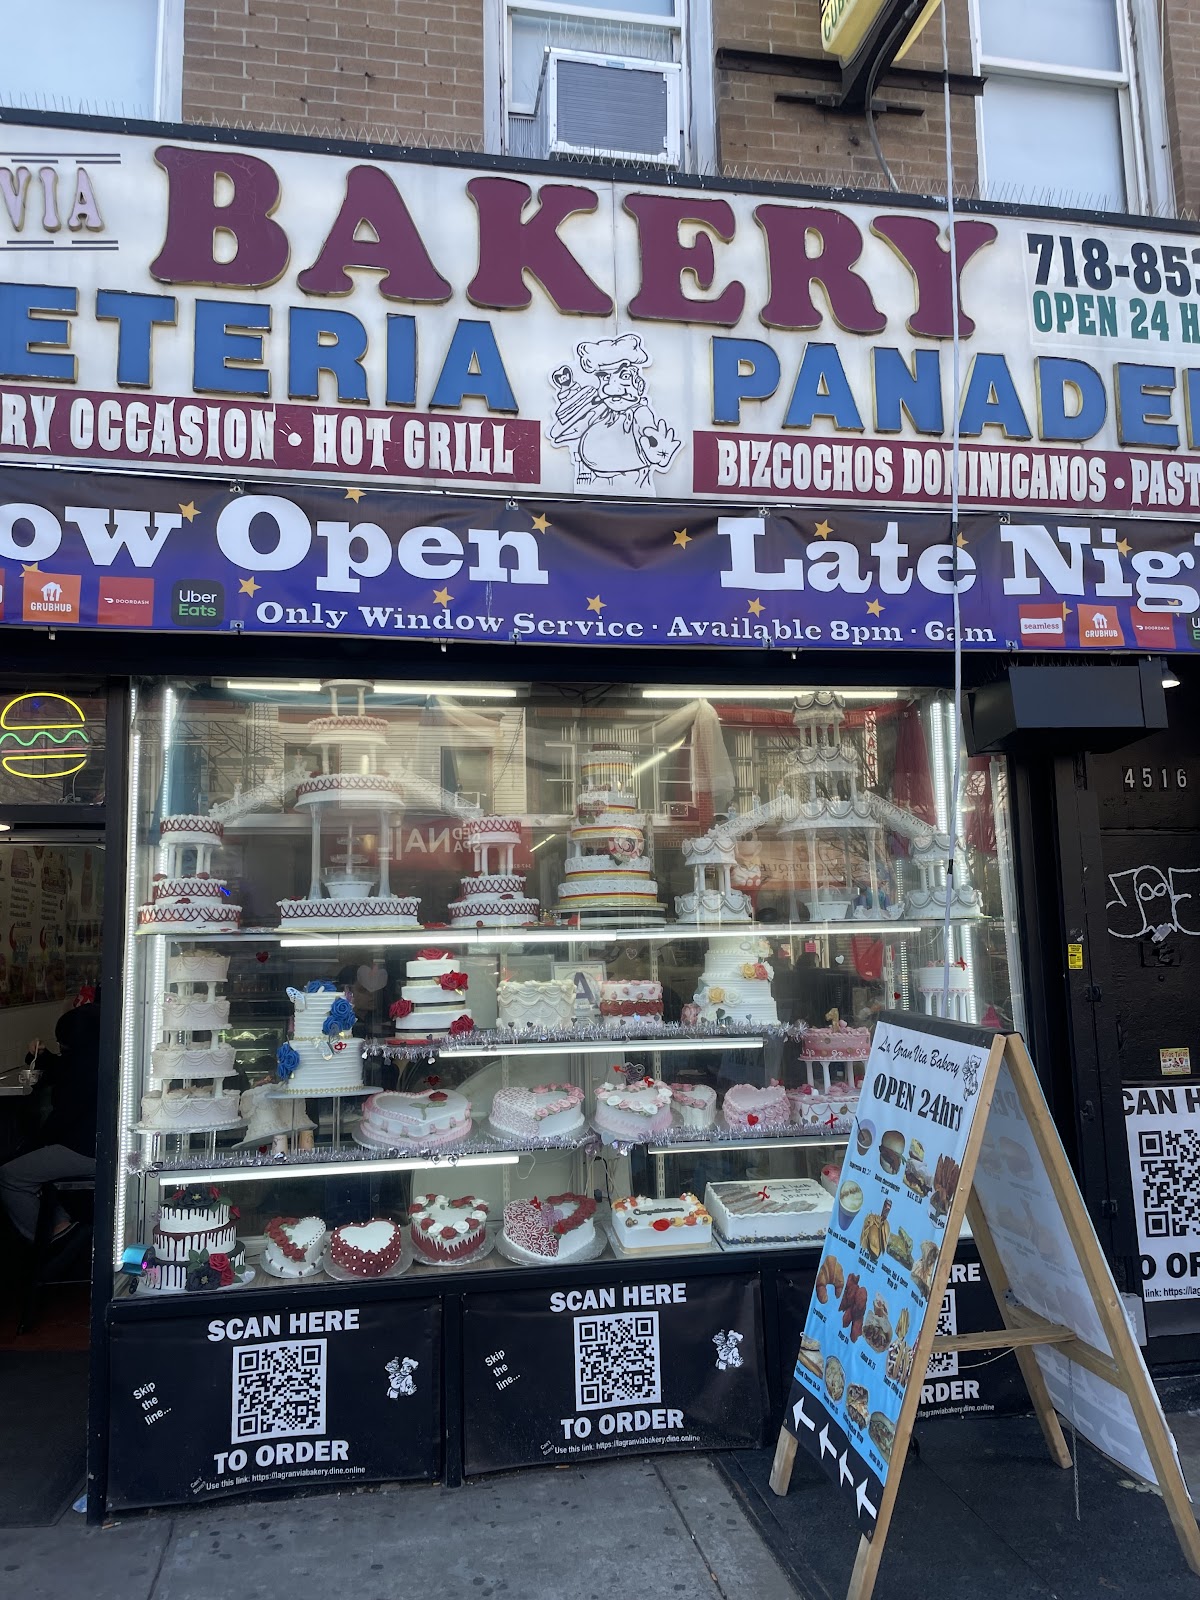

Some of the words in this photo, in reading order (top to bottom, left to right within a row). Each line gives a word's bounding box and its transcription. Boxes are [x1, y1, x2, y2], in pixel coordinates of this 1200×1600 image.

[0, 166, 104, 233] VIA
[149, 145, 998, 339] BAKERY
[1033, 290, 1118, 338] OPEN
[1129, 297, 1169, 342] 24
[0, 282, 519, 414] ETERIA
[0, 391, 57, 452] RY
[70, 396, 278, 468] OCCASION
[312, 411, 393, 471] HOT
[402, 418, 519, 476] GRILL
[716, 437, 893, 494] BIZCOCHOS
[902, 446, 1106, 503] DOMINICANOS
[1129, 457, 1200, 507] PAST
[0, 503, 182, 568] ow
[216, 494, 549, 593] Open
[717, 516, 977, 595] Late
[1001, 524, 1200, 614] Nig
[30, 602, 72, 612] GRUBHUB
[115, 598, 150, 606] DOORDASH
[179, 589, 217, 604] Uber
[178, 604, 217, 617] Eats
[256, 601, 349, 630] Only
[358, 606, 505, 633] Window
[514, 612, 644, 639] Service
[667, 615, 822, 642] Available
[830, 621, 904, 647] 8pm
[924, 621, 997, 645] 6am
[1023, 622, 1060, 631] seamless
[1085, 630, 1118, 638] GRUBHUB
[1124, 768, 1187, 789] 4516
[574, 972, 596, 1004] A
[878, 1036, 891, 1053] La
[893, 1039, 913, 1060] Gran
[914, 1045, 928, 1065] Via
[930, 1049, 960, 1079] Bakery
[873, 1073, 917, 1113] OPEN
[917, 1089, 963, 1132] 24hrs
[947, 1262, 981, 1284] RE
[549, 1287, 615, 1313] SCAN
[623, 1282, 687, 1307] HERE
[207, 1314, 281, 1342] SCAN
[289, 1308, 360, 1335] HERE
[485, 1348, 506, 1368] Skip
[493, 1362, 508, 1378] the
[496, 1372, 521, 1391] line...
[132, 1381, 156, 1400] Skip
[920, 1380, 980, 1405] RDER
[141, 1395, 159, 1411] the
[144, 1405, 173, 1426] line...
[560, 1417, 592, 1440] TO
[599, 1408, 684, 1434] ORDER
[213, 1449, 248, 1475] TO
[255, 1440, 349, 1468] ORDER
[554, 1445, 568, 1454] Use
[568, 1444, 581, 1453] this
[206, 1481, 220, 1491] Use
[221, 1479, 234, 1489] this
[235, 1476, 250, 1486] link:
